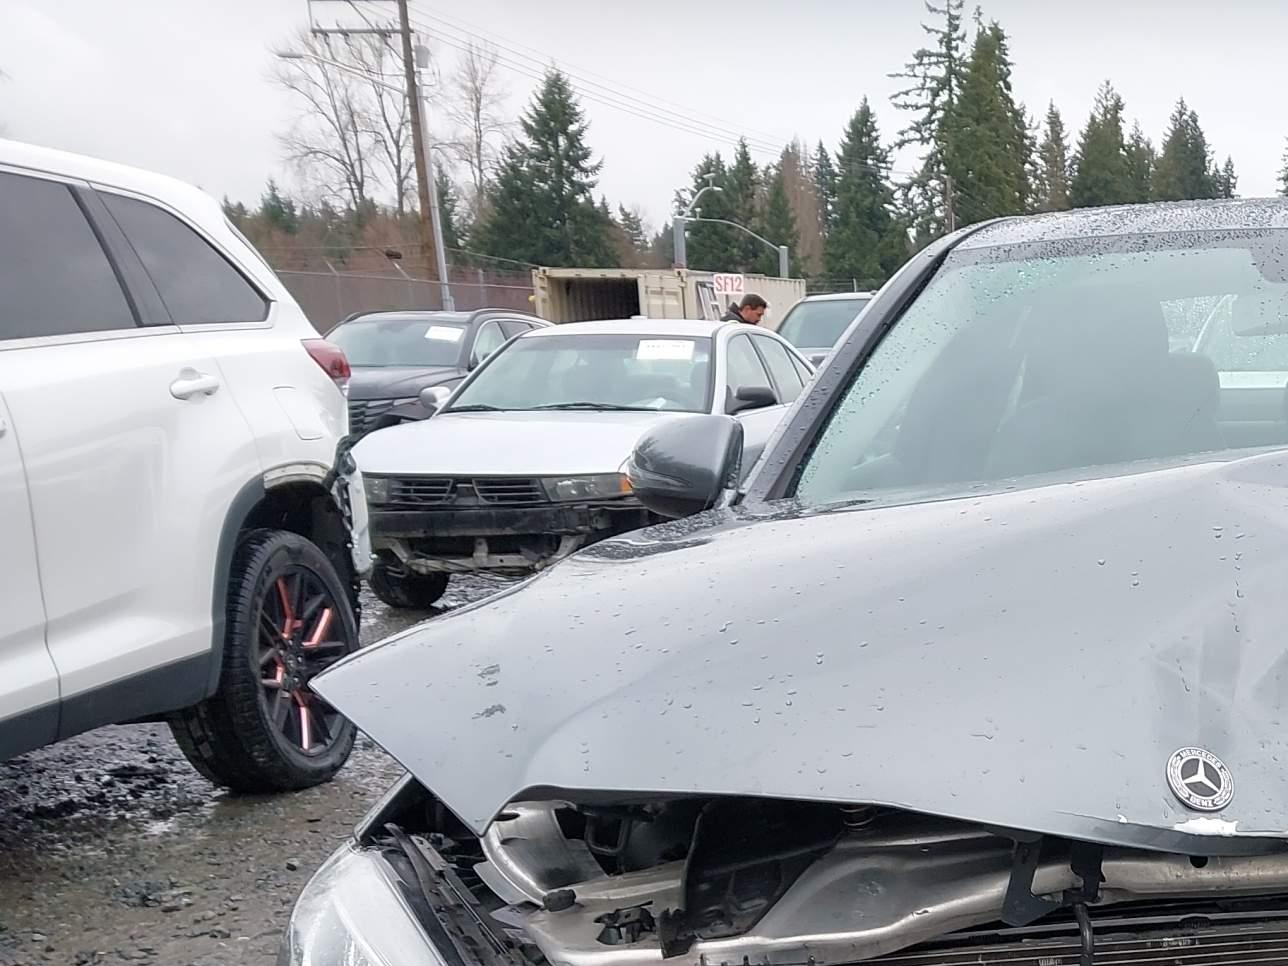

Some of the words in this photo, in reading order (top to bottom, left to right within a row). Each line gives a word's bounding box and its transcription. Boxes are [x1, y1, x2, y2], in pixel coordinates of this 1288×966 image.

[715, 275, 743, 292] SF12
[1179, 749, 1222, 769] MERCEDES
[1190, 795, 1214, 808] BENZ
